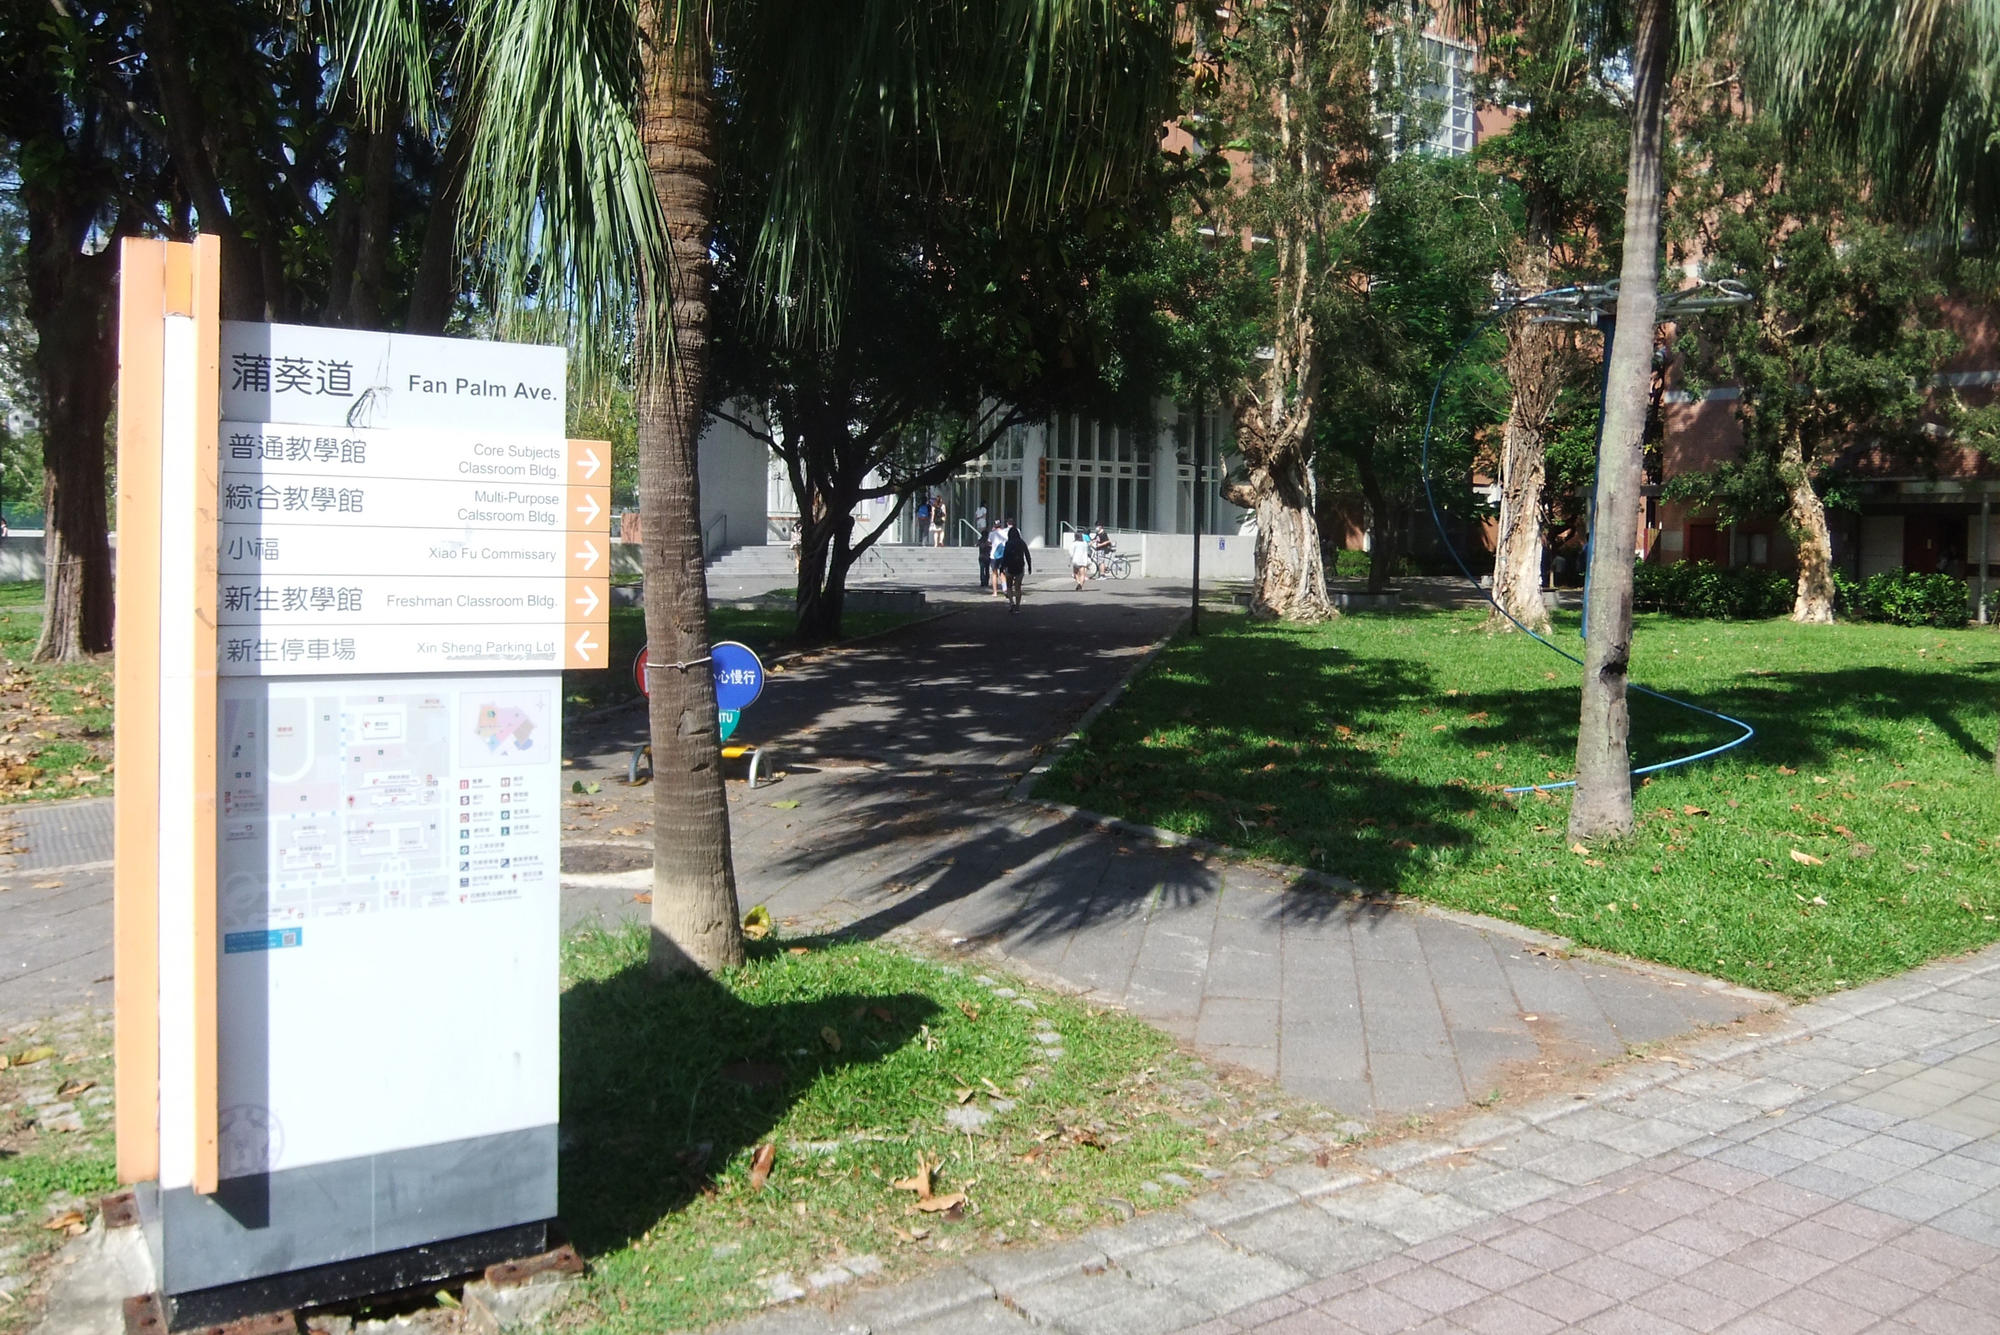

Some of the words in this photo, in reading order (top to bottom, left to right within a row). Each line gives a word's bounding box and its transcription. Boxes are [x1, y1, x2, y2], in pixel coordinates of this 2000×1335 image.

[232, 353, 354, 398] 蒲葵道
[408, 374, 447, 394] Fan
[455, 378, 506, 398] Palm
[513, 382, 558, 401] Ave.
[229, 434, 366, 464] 普通教學館
[473, 443, 504, 457] Core
[508, 445, 560, 461] Subjects
[458, 461, 526, 476] Classroom
[529, 464, 560, 479] Bldg.
[225, 484, 364, 513] 綜合教學館
[474, 490, 559, 506] Multi-Purpose
[457, 508, 525, 522] Calssroom
[528, 510, 559, 526] Bldg.
[227, 536, 279, 561] 小福
[428, 547, 457, 559] Xiao
[460, 547, 477, 560] Fu
[481, 547, 557, 563] Commissary
[224, 586, 362, 613] 新生教學館
[386, 594, 453, 607] Freshman
[456, 594, 523, 607] Classroom
[527, 594, 558, 610] Bldg.
[226, 638, 356, 663] 新生停車場
[416, 642, 438, 654] Xin
[441, 642, 482, 657] Sheng
[485, 641, 532, 656] Parking
[536, 641, 555, 653] Lot
[713, 670, 756, 685] 心慢行
